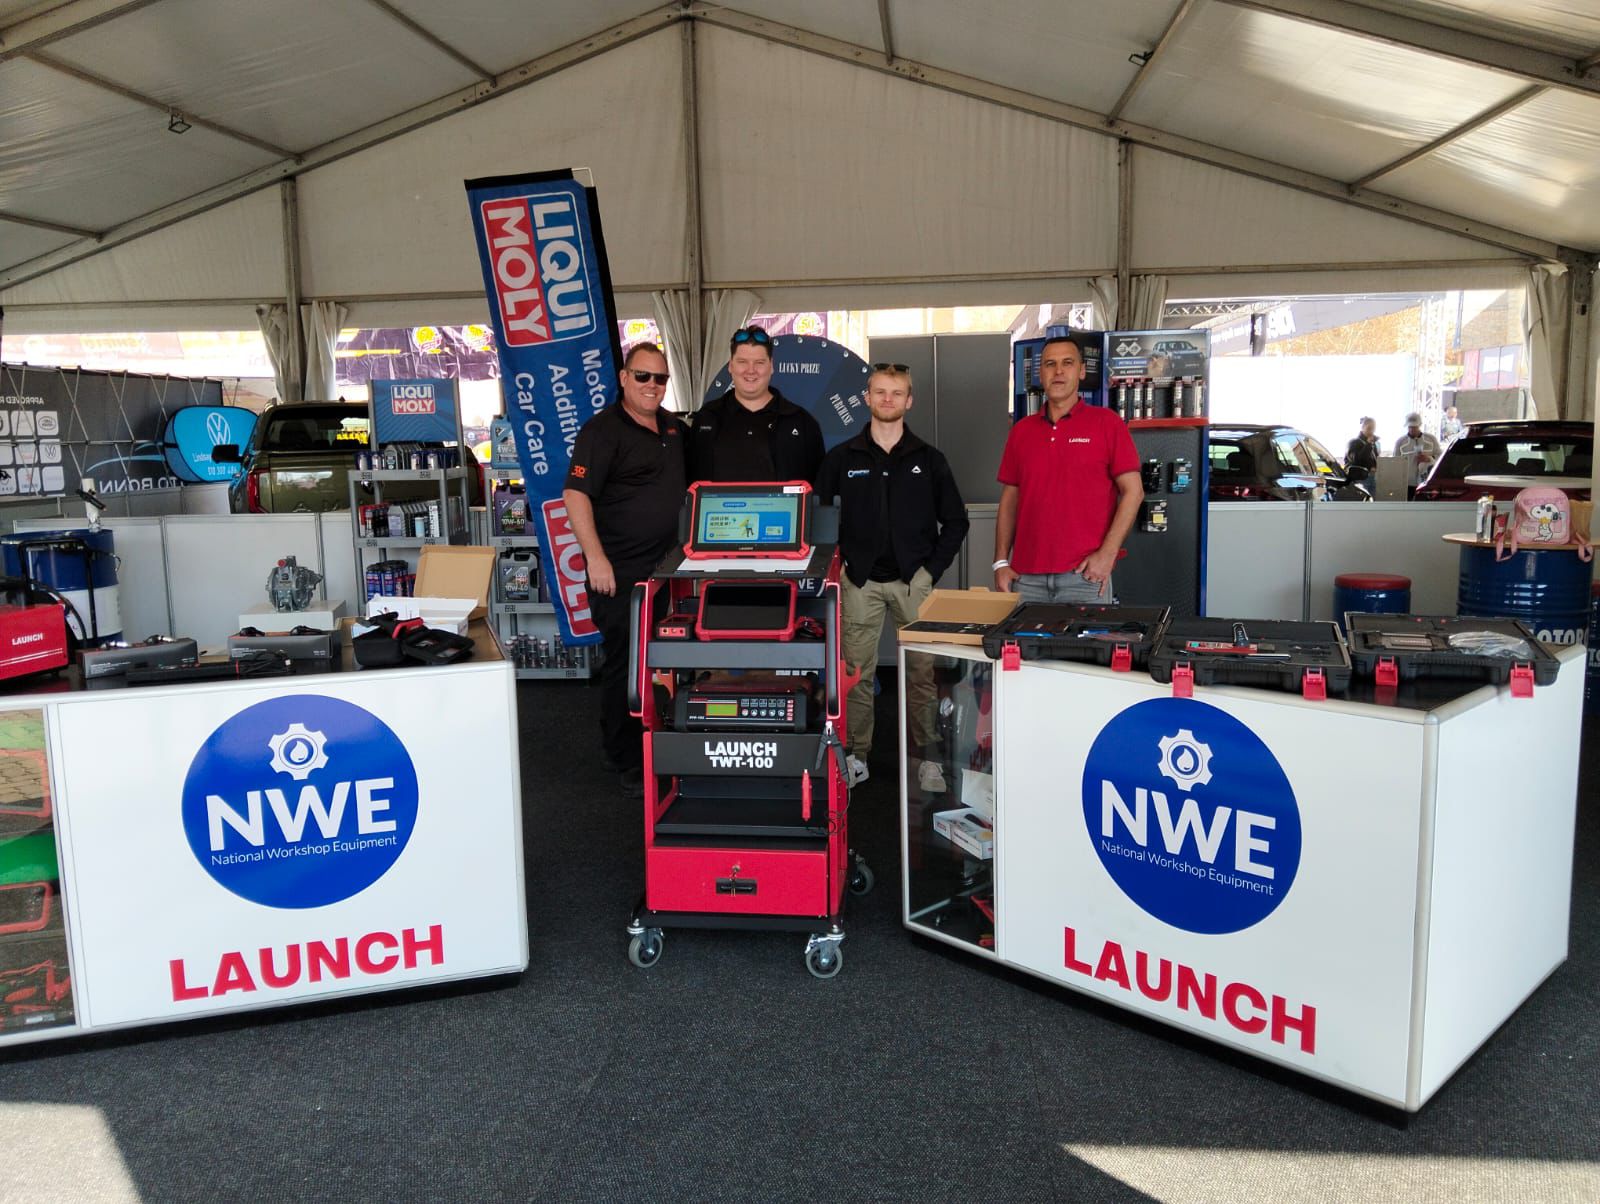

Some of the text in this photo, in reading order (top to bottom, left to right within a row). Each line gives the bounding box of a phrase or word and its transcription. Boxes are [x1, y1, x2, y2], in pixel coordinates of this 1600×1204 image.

[487, 206, 549, 339] MOLY
[532, 201, 591, 332] LIQUI
[393, 386, 432, 399] LIQUI
[800, 362, 820, 375] PRIZE
[394, 399, 434, 412] MOLY
[515, 372, 549, 475] Car Care
[12, 632, 44, 646] LAUNCH
[704, 741, 777, 757] LAUNCH
[709, 756, 773, 768] TWT-100
[205, 777, 397, 852] NWE
[1102, 779, 1276, 880] NWE
[211, 835, 397, 866] National Workshop Equipment
[1101, 840, 1274, 896] National Workshop Equipment
[169, 924, 445, 1002] LAUNCH
[1064, 926, 1317, 1056] LAUNCH
